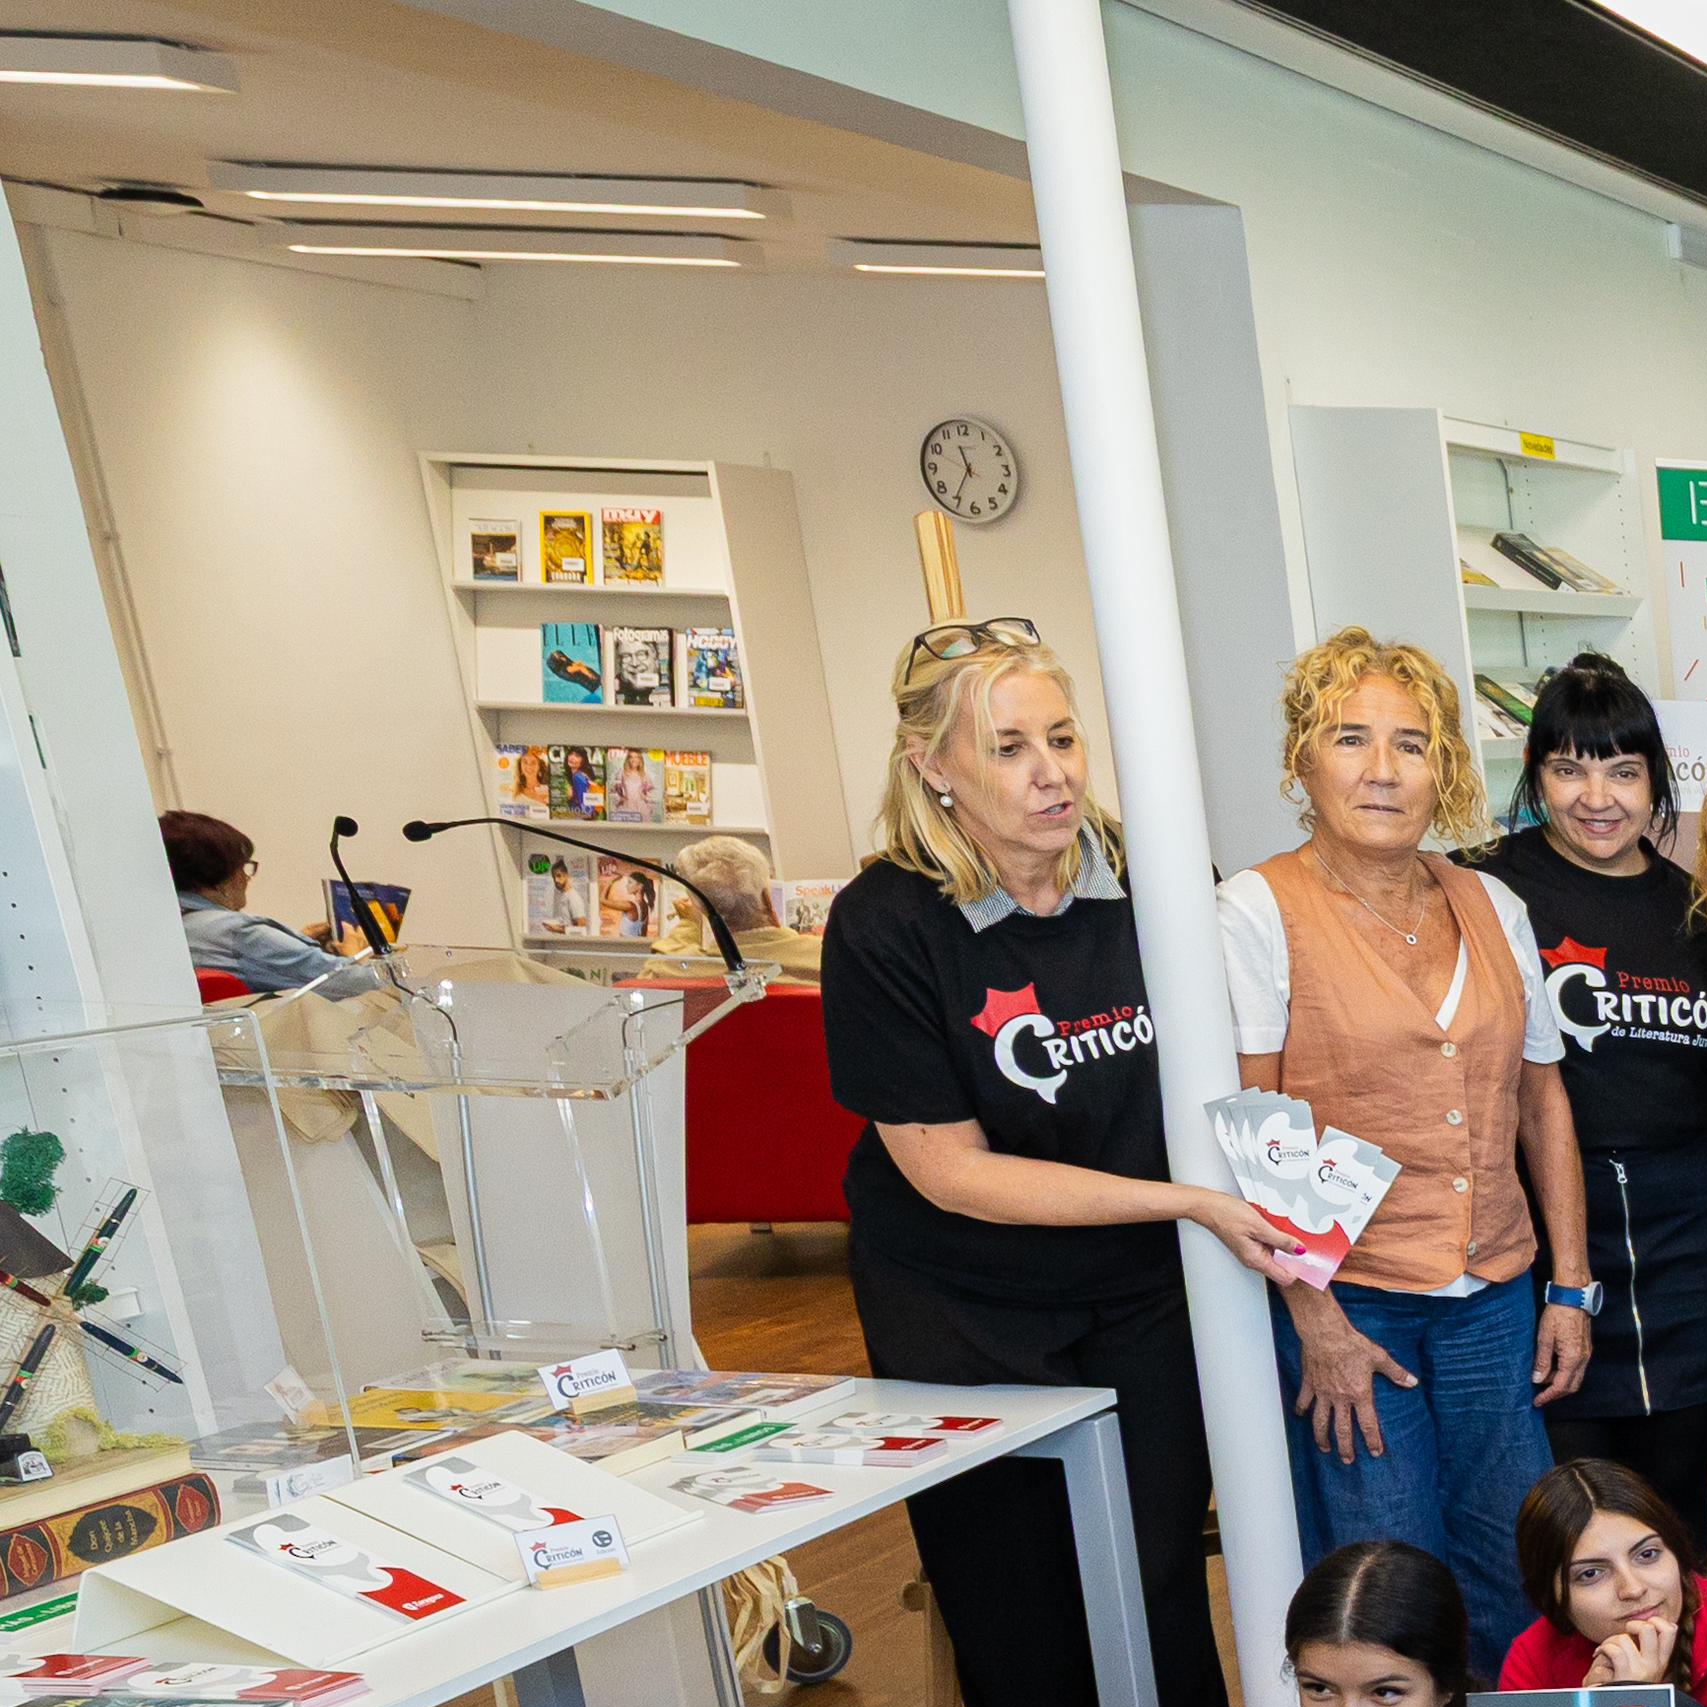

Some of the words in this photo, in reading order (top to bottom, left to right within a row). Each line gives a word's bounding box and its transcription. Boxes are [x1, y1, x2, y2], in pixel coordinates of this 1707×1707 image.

[942, 430, 950, 440] 11
[957, 425, 970, 437] 12
[931, 443, 943, 455] 10
[993, 445, 1002, 457] 2
[927, 462, 938, 475] 9
[1001, 464, 1011, 477] 3
[936, 481, 948, 494] 8
[998, 483, 1008, 495] 4
[952, 496, 962, 509] 7
[969, 501, 981, 515] 6
[988, 497, 998, 510] 5
[1616, 971, 1691, 994] Premio
[1057, 1004, 1134, 1037] Premio
[1611, 1025, 1627, 1037] de
[1629, 1026, 1690, 1045] Literatura
[555, 1369, 617, 1399] CRITICÓN
[88, 1530, 99, 1551] Don
[534, 1546, 583, 1570] CRITICÓN
